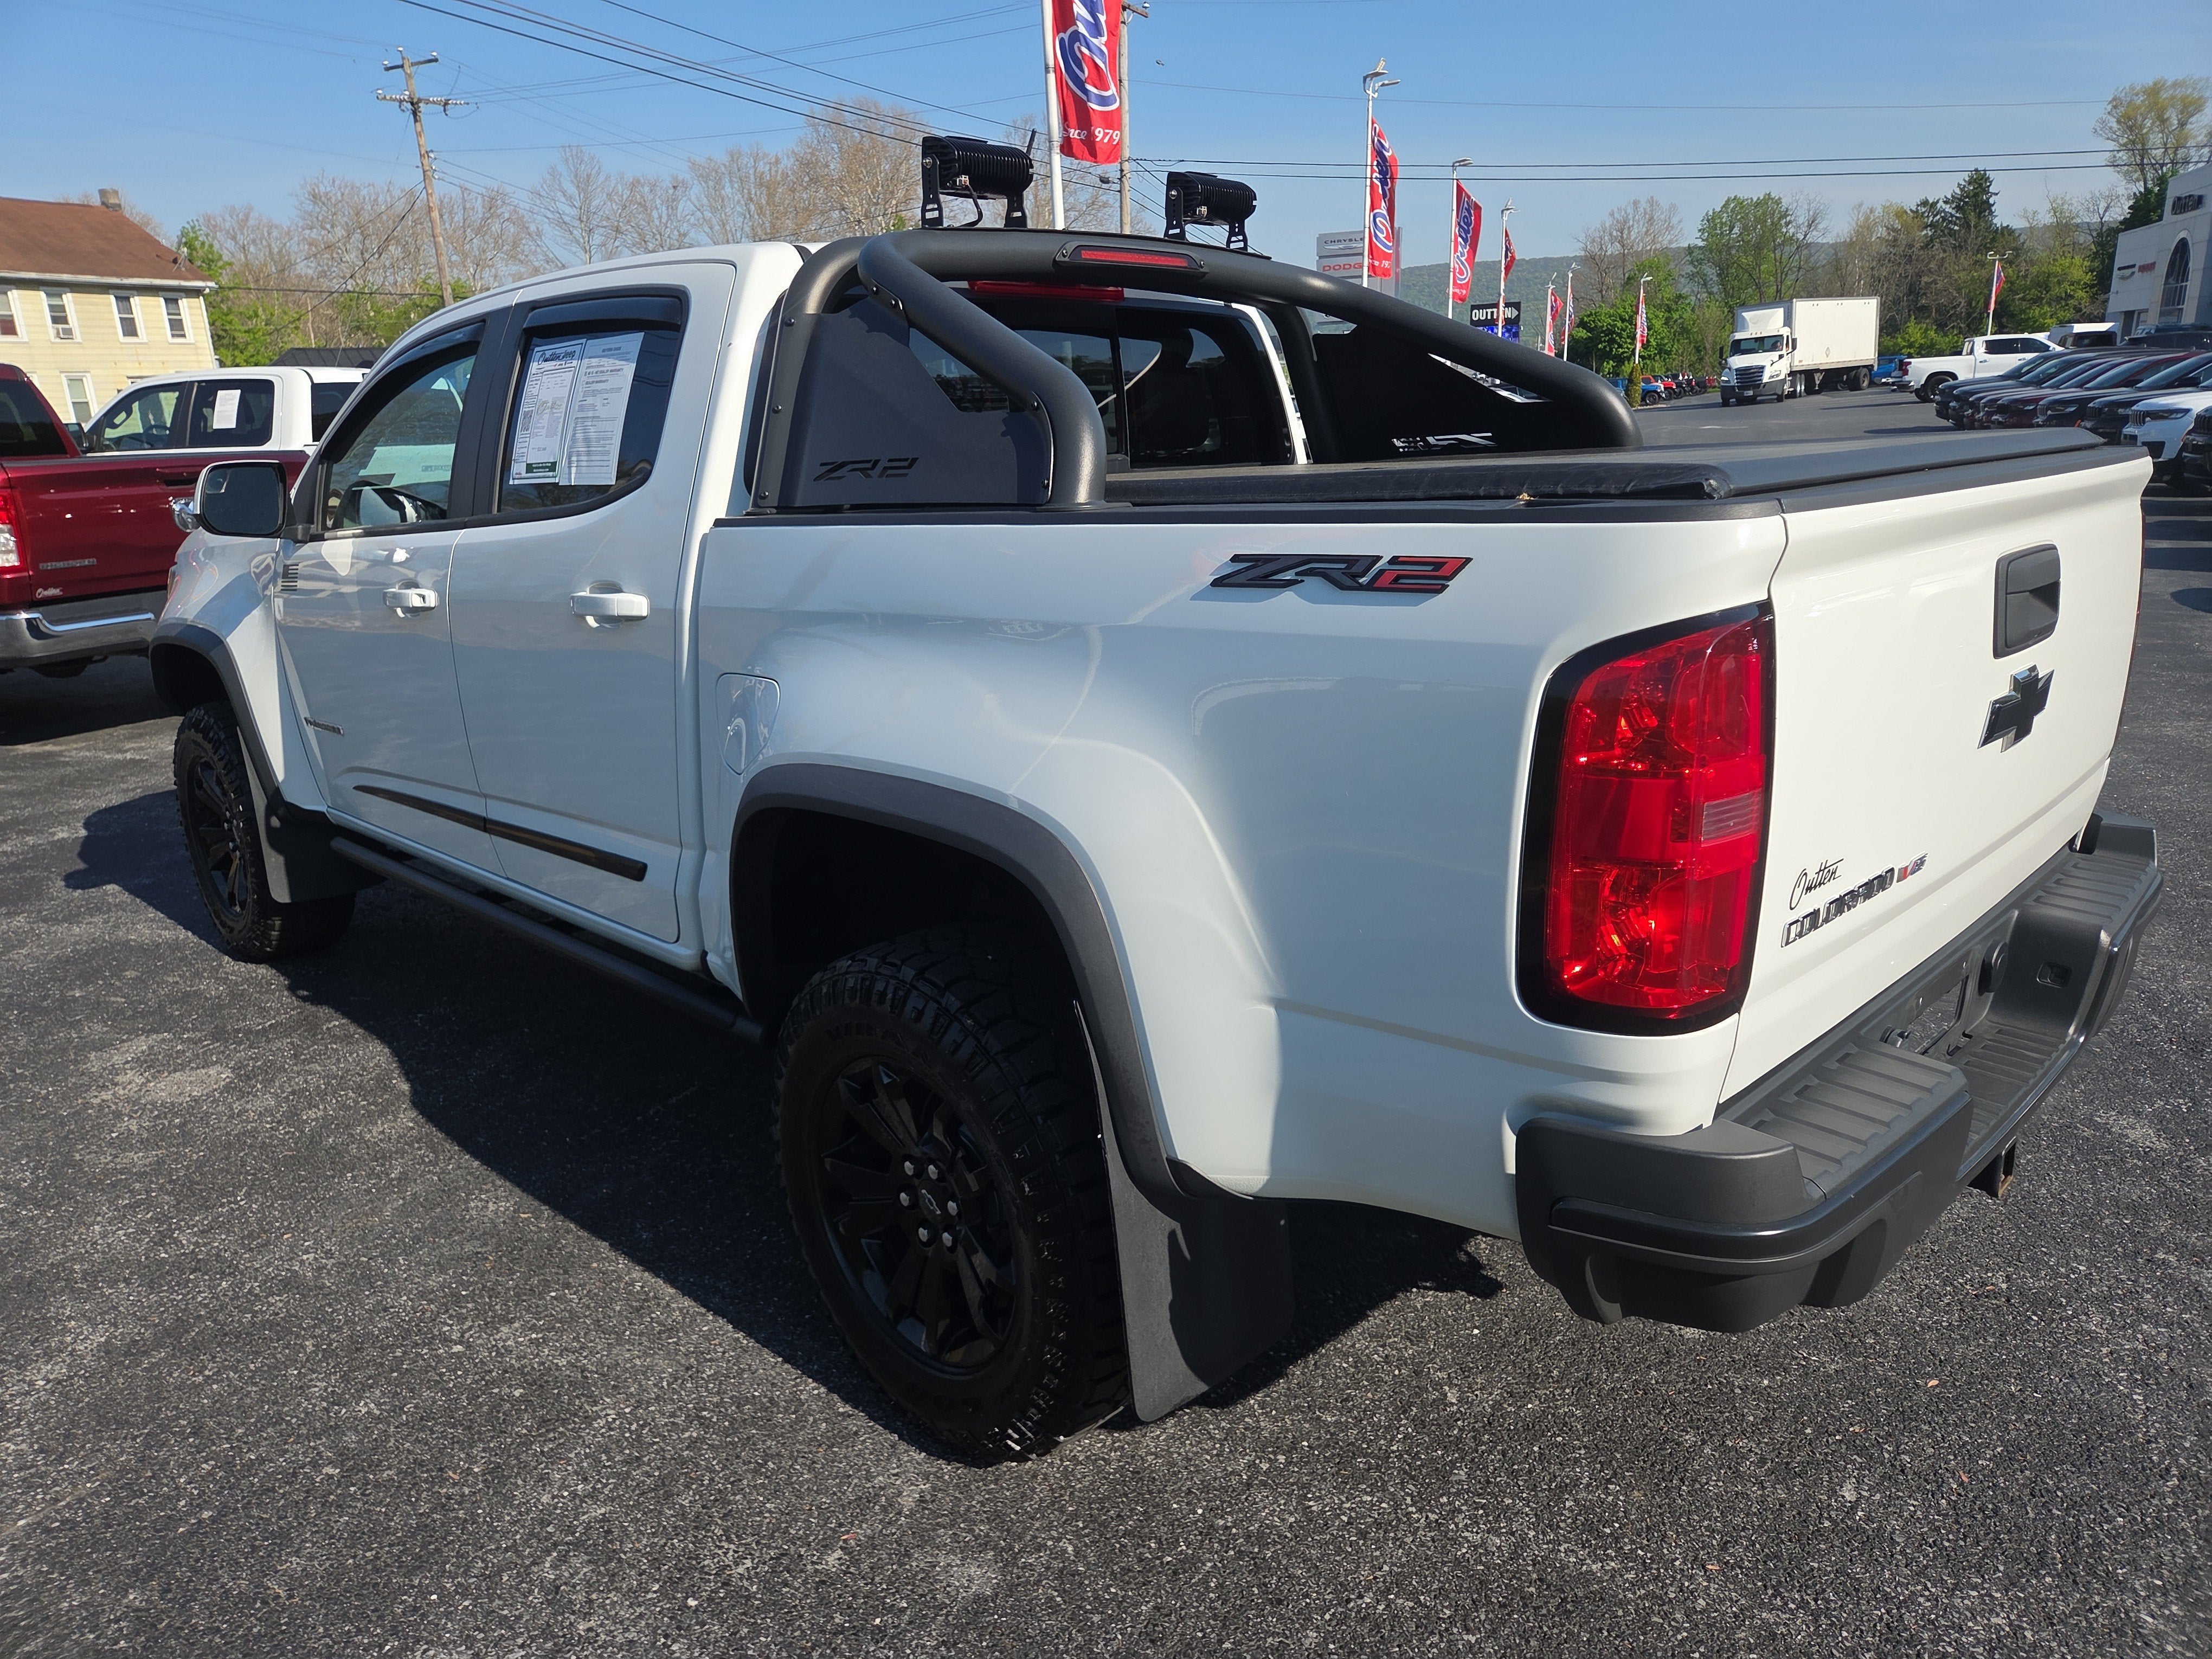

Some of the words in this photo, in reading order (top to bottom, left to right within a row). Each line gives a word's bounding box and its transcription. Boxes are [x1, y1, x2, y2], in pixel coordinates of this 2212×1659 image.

[1322, 262, 1363, 272] DODG
[1472, 307, 1512, 320] OUTTN
[813, 458, 919, 482] ZR2
[1210, 554, 1473, 594] ZR2
[1790, 858, 1844, 911] Outten
[1781, 865, 1895, 948] COLORADO
